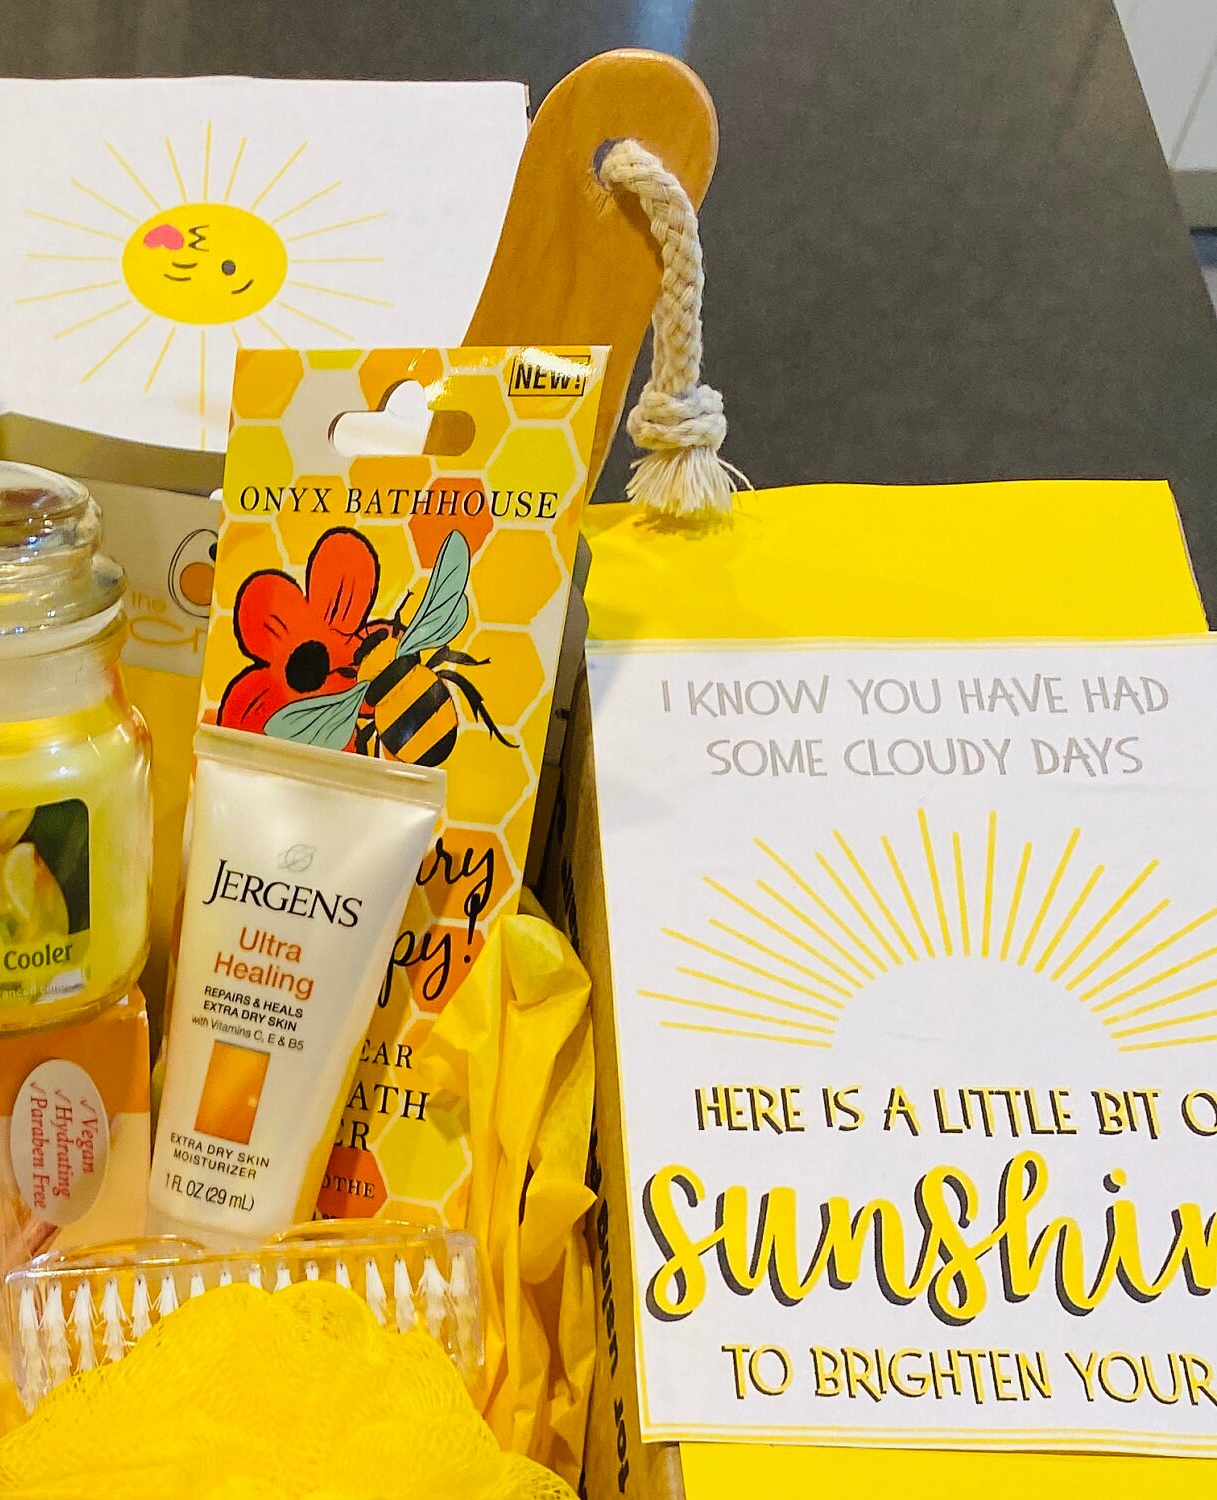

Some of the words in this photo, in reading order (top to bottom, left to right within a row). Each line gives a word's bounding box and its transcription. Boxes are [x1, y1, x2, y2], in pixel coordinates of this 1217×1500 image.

[514, 362, 581, 390] NEW!
[240, 485, 331, 515] ONYX
[344, 487, 560, 521] BATHHOUSE
[660, 678, 672, 715] I
[686, 674, 830, 717] KNOW
[846, 677, 943, 715] YOU
[958, 675, 1064, 717] HAVE
[1083, 675, 1170, 715] HAD
[705, 737, 828, 779] SOME
[843, 735, 1012, 779] CLOUDY
[1032, 735, 1144, 779] DAYS
[202, 858, 364, 928] JERGENS
[2, 943, 74, 972] Cooler
[238, 926, 303, 964] Ultra
[212, 951, 315, 1002] Healing
[203, 985, 252, 1006] REPAIRS
[252, 997, 261, 1009] &
[262, 1000, 304, 1019] HEALS
[203, 1000, 239, 1018] EXTRA
[240, 1006, 267, 1024] DRY
[267, 1016, 297, 1032] SKIN
[191, 1014, 210, 1028] with
[210, 1017, 252, 1039] Vitamins
[267, 1032, 277, 1044] E
[277, 1035, 286, 1047] &
[287, 1037, 305, 1051] B5
[358, 1038, 414, 1070] EAR
[344, 1081, 431, 1122] ATH
[692, 1083, 805, 1136] HERE
[822, 1084, 866, 1135] IS
[881, 1085, 920, 1138] A
[933, 1086, 1079, 1139] LITTLE
[1090, 1087, 1162, 1139] BIT
[1180, 1087, 1217, 1138] O
[30, 1095, 50, 1168] Paraben
[75, 1117, 99, 1175] Vegan
[170, 1131, 204, 1153] EXTRA
[206, 1143, 235, 1160] DRY
[237, 1152, 271, 1169] SKIN
[50, 1104, 75, 1199] Hydrating
[173, 1148, 258, 1180] MOISTURIZER
[32, 1173, 51, 1209] Free
[165, 1172, 171, 1190] 1
[171, 1174, 184, 1194] FL
[186, 1180, 205, 1200] OZ
[205, 1186, 228, 1206] (29
[228, 1194, 256, 1213] mL)
[720, 1342, 794, 1402] TO
[808, 1343, 1053, 1406] BRIGHTEN
[1064, 1347, 1217, 1407] YOUR
